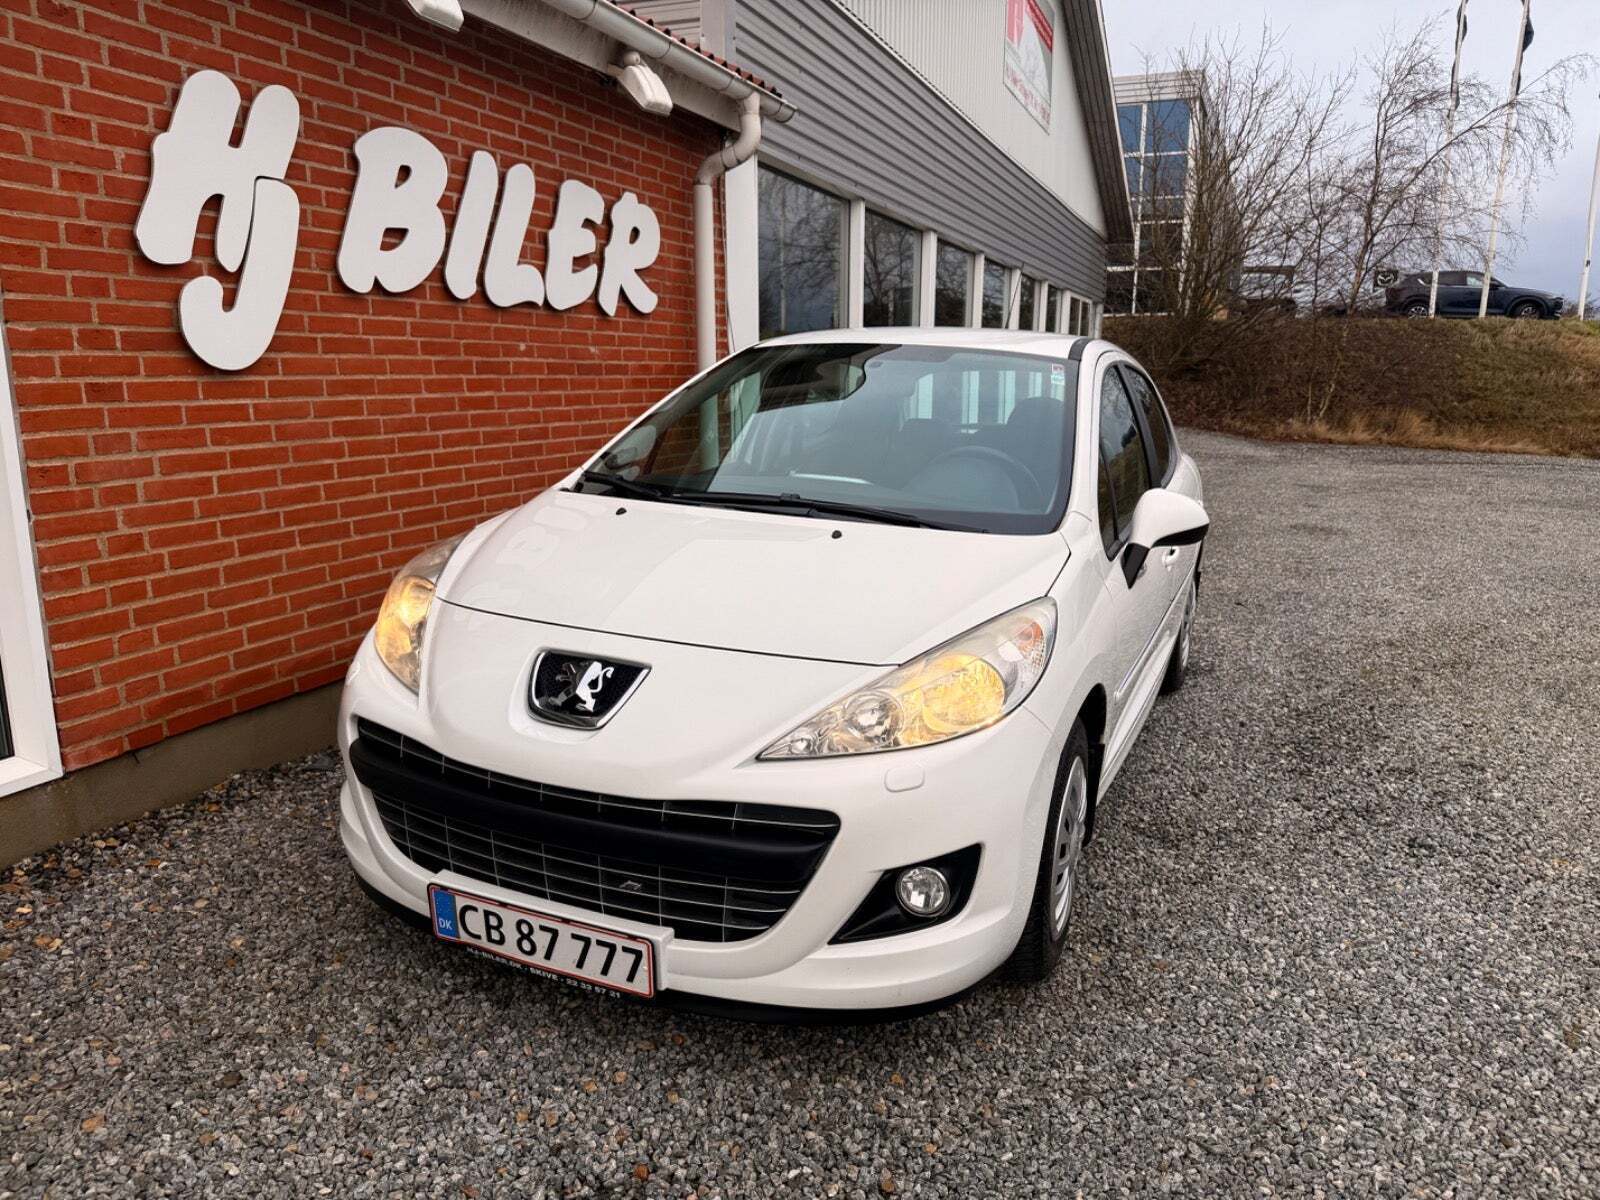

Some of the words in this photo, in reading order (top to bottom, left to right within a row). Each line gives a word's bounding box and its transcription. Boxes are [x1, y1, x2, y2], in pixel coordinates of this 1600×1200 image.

[336, 126, 661, 316] BILER
[439, 917, 453, 930] DK
[459, 904, 506, 946] CB
[515, 918, 560, 961] 87
[570, 932, 644, 984] 777
